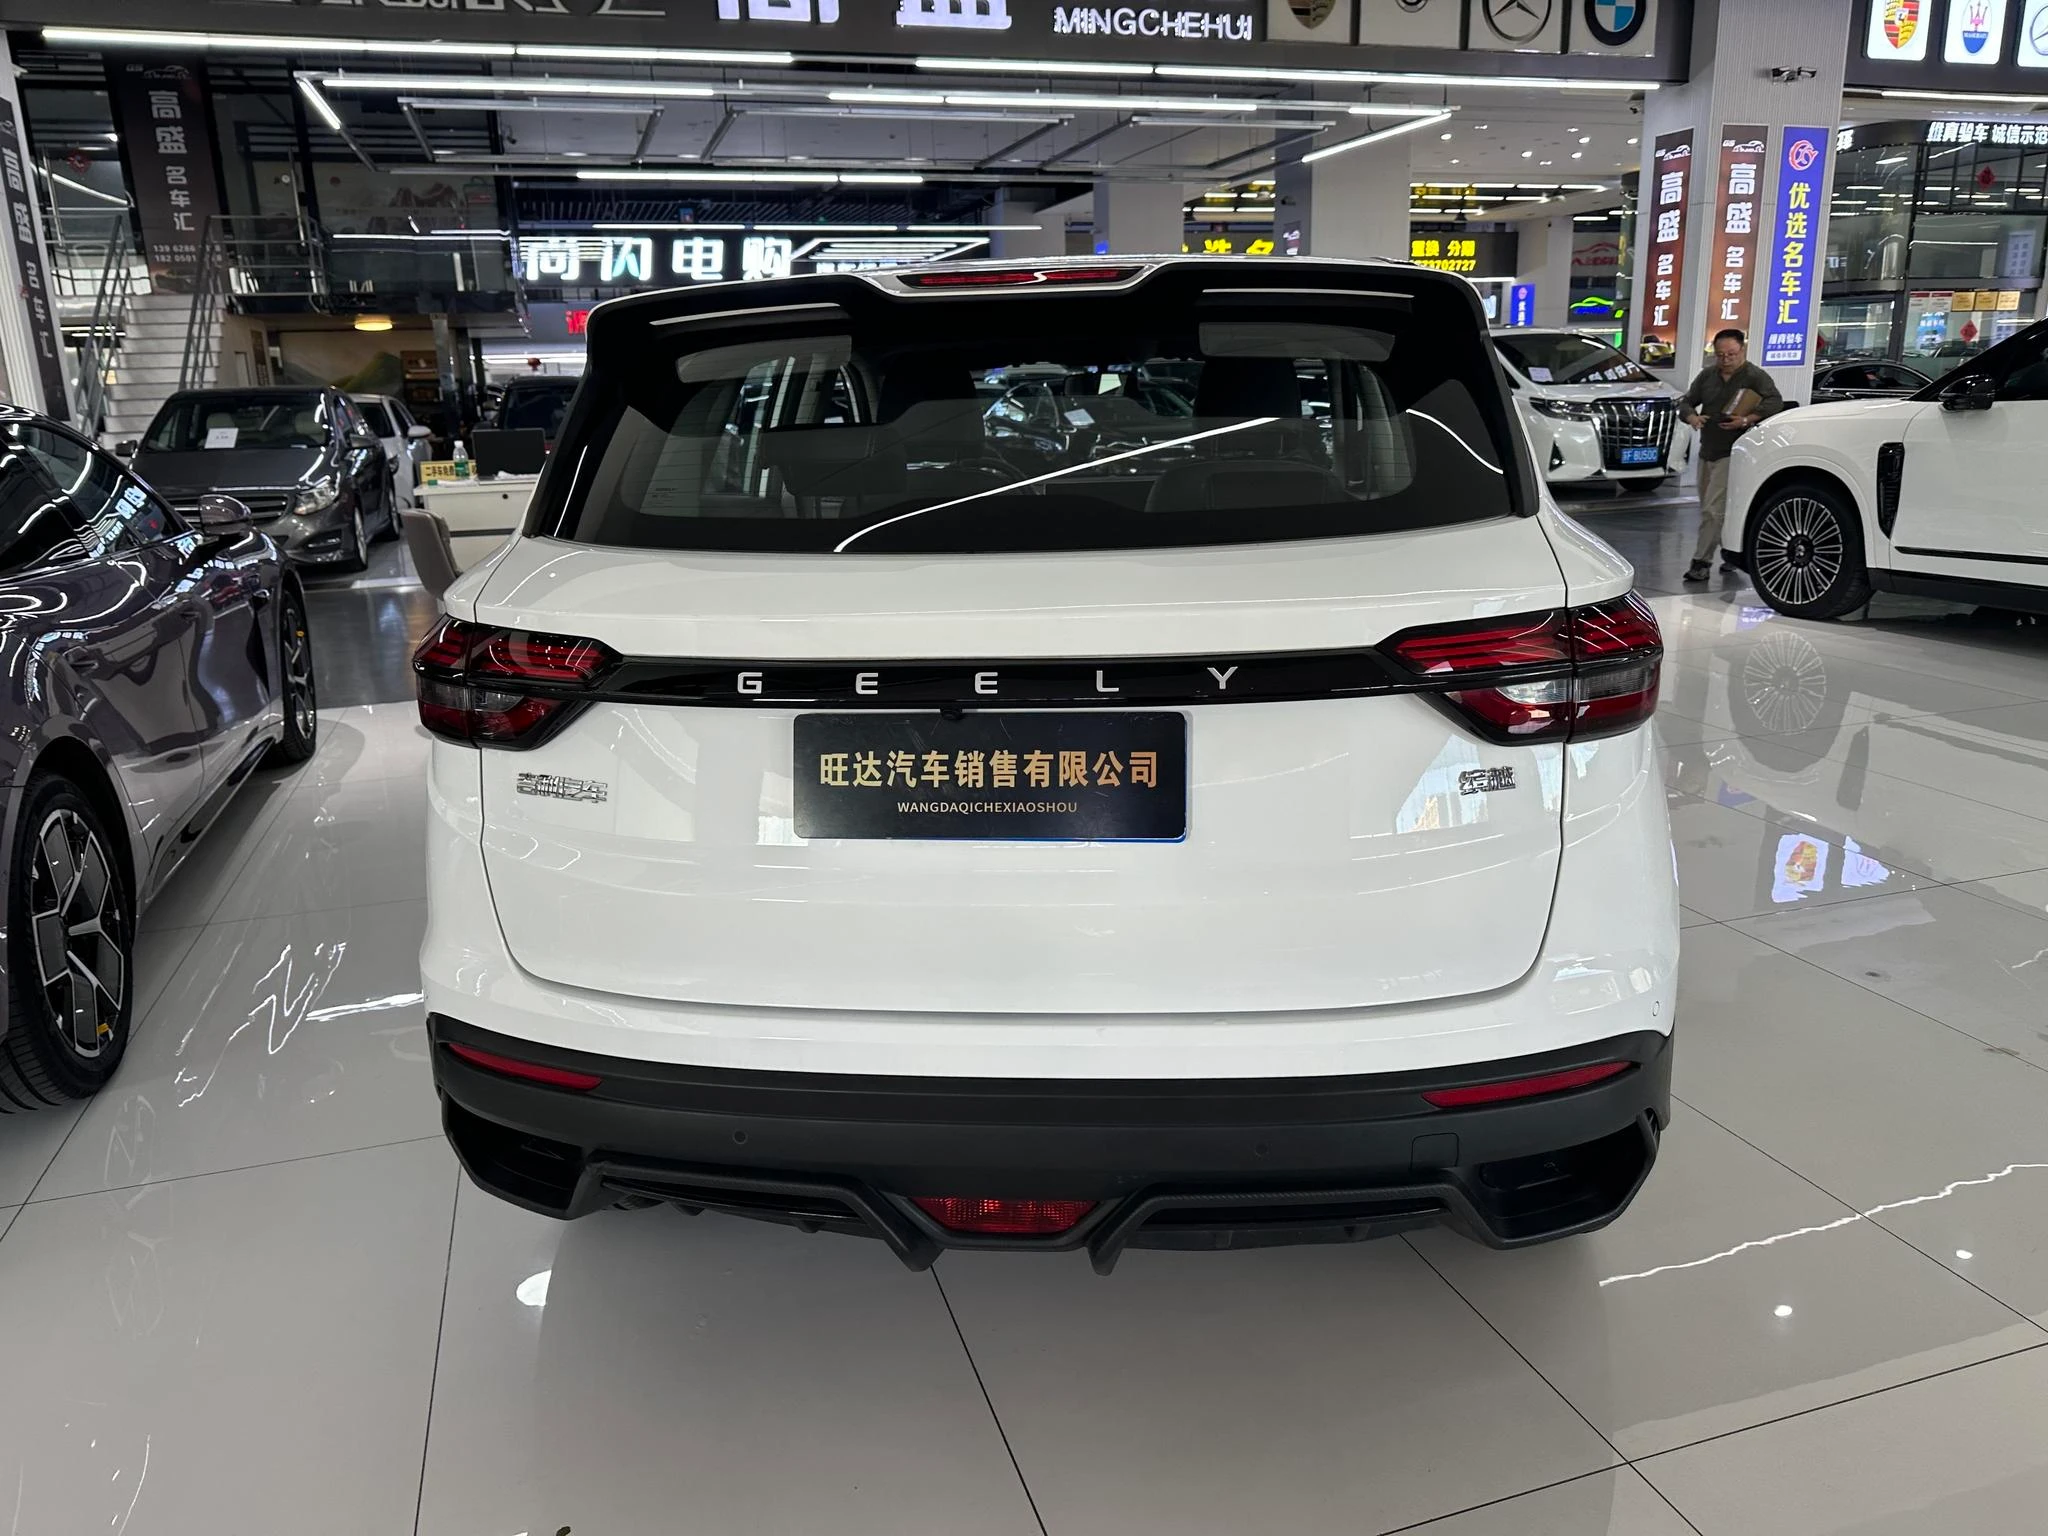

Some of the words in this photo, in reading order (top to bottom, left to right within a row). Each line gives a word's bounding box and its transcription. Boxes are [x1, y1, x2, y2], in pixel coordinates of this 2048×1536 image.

[1053, 6, 1253, 41] MINGCHEHUI
[1777, 182, 1811, 325] 优选名车汇
[737, 666, 1238, 695] GEELY
[819, 750, 1158, 789] 旺达汽车销售有限公司
[897, 801, 1078, 815] WANGDAQICHEXIAOSHOU
